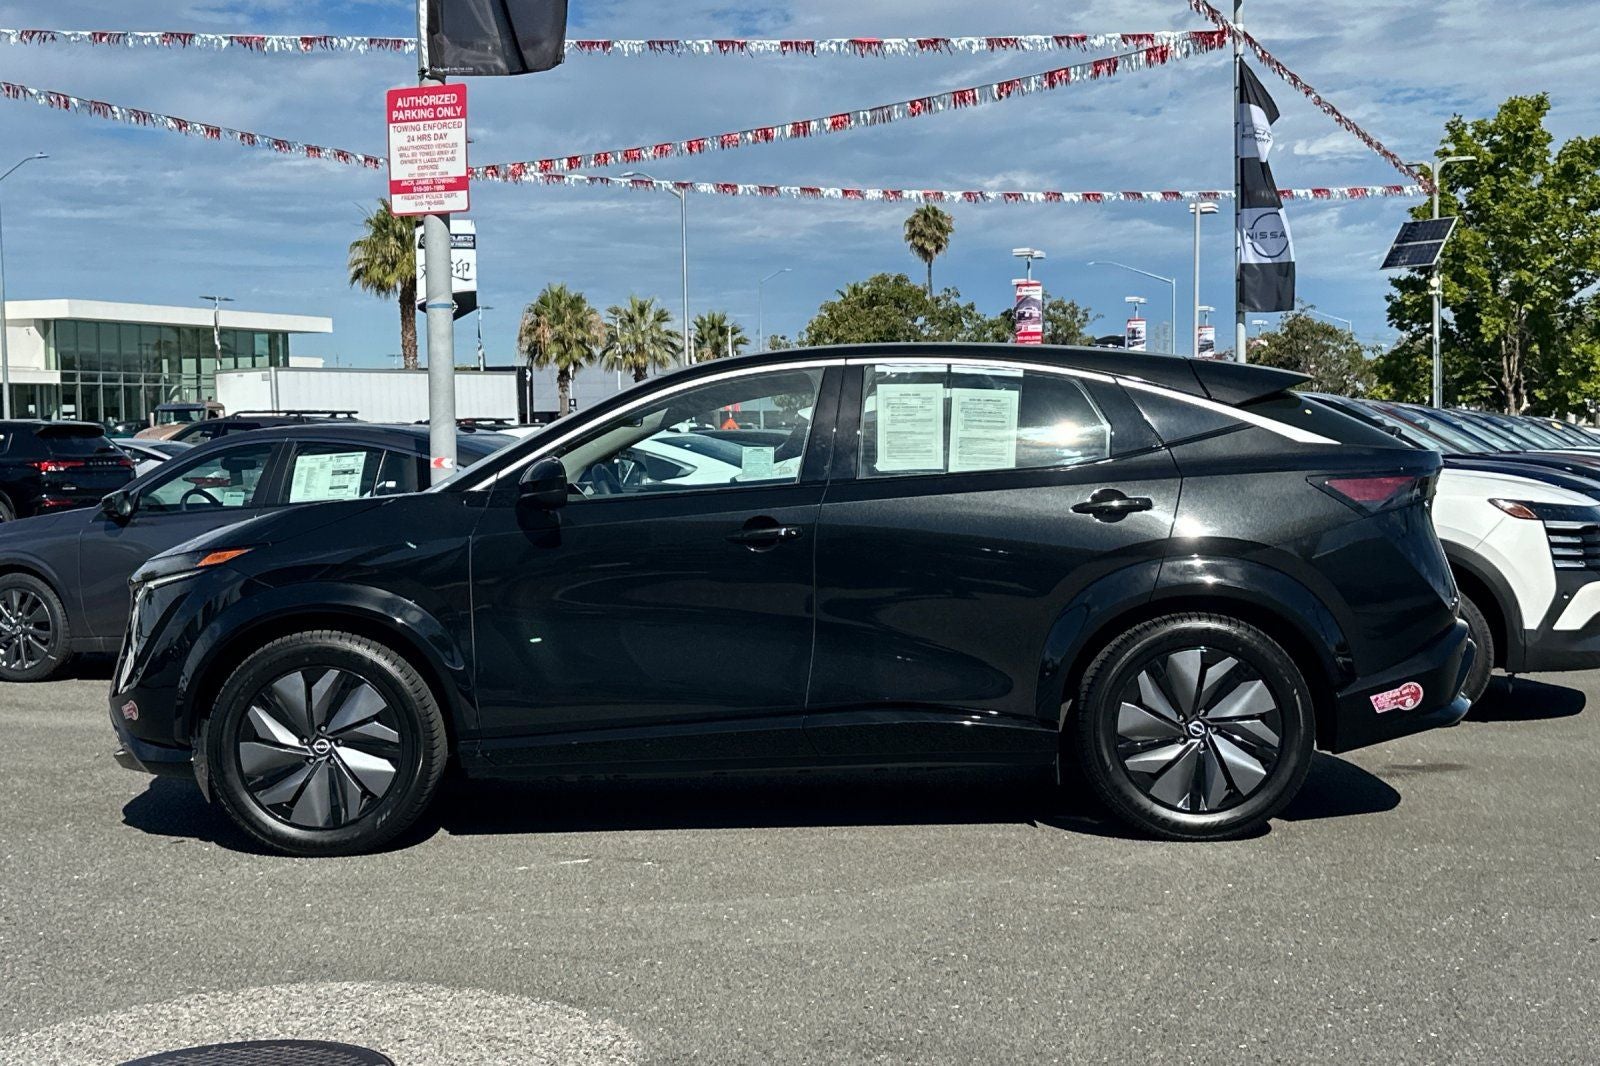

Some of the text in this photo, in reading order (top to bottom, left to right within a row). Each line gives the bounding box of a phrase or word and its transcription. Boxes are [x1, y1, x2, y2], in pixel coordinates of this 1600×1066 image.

[396, 93, 458, 108] AUTHORIZED
[392, 106, 462, 121] PARKING ONLY
[392, 121, 463, 133] TOWING ENFORCED
[406, 133, 448, 143] 24 HRS DAY
[1246, 231, 1287, 239] NISSA
